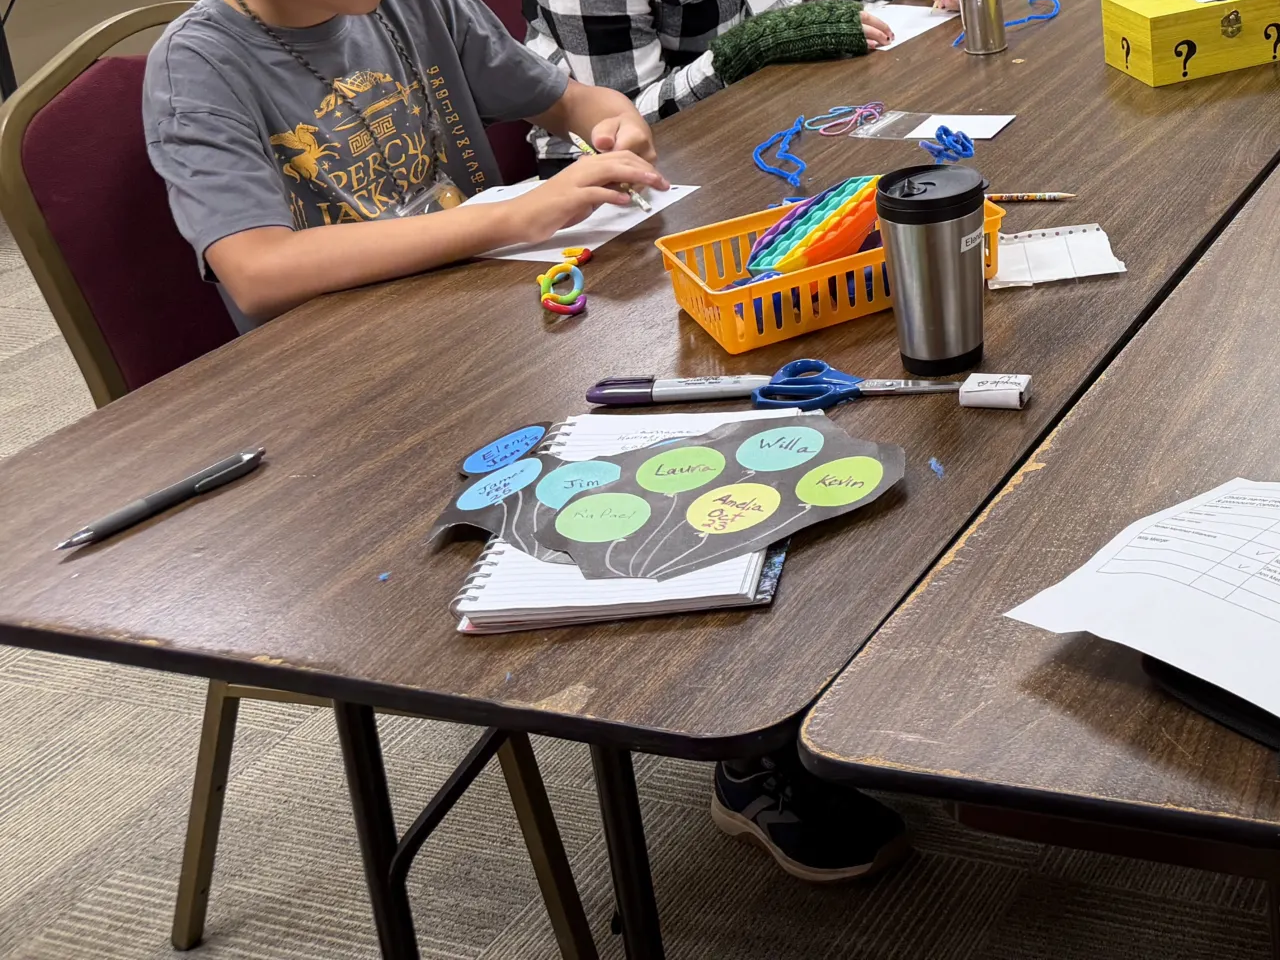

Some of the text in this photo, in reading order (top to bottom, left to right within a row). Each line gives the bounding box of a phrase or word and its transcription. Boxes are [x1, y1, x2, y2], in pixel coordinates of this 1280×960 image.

[328, 126, 427, 191] PERCY
[760, 436, 816, 454] Willa
[564, 478, 599, 489] Jim
[816, 474, 865, 489] Kevin
[713, 494, 765, 512] Amelia
[707, 508, 746, 523] Oct
[701, 519, 728, 530] 23
